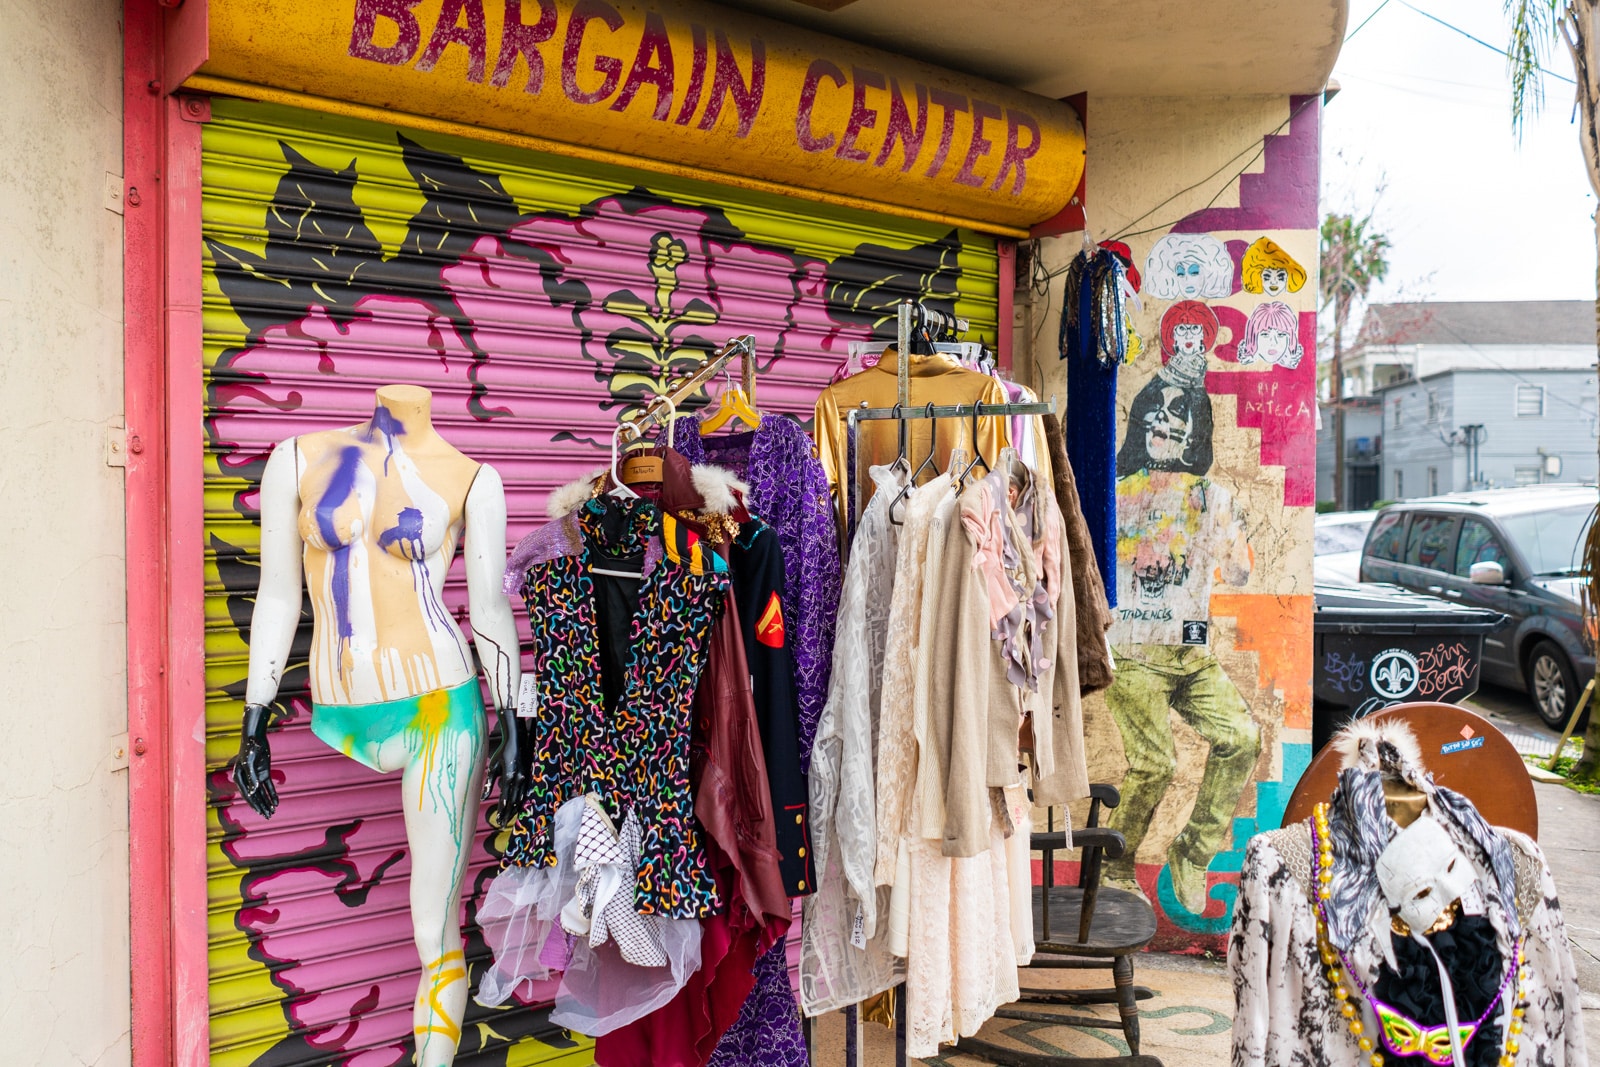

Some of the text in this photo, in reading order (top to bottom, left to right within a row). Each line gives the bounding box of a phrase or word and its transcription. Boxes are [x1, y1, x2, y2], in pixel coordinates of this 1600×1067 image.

[347, 0, 1041, 197] BARGAIN CENTER
[1257, 382, 1279, 397] RIP
[1245, 400, 1311, 418] AZTECA
